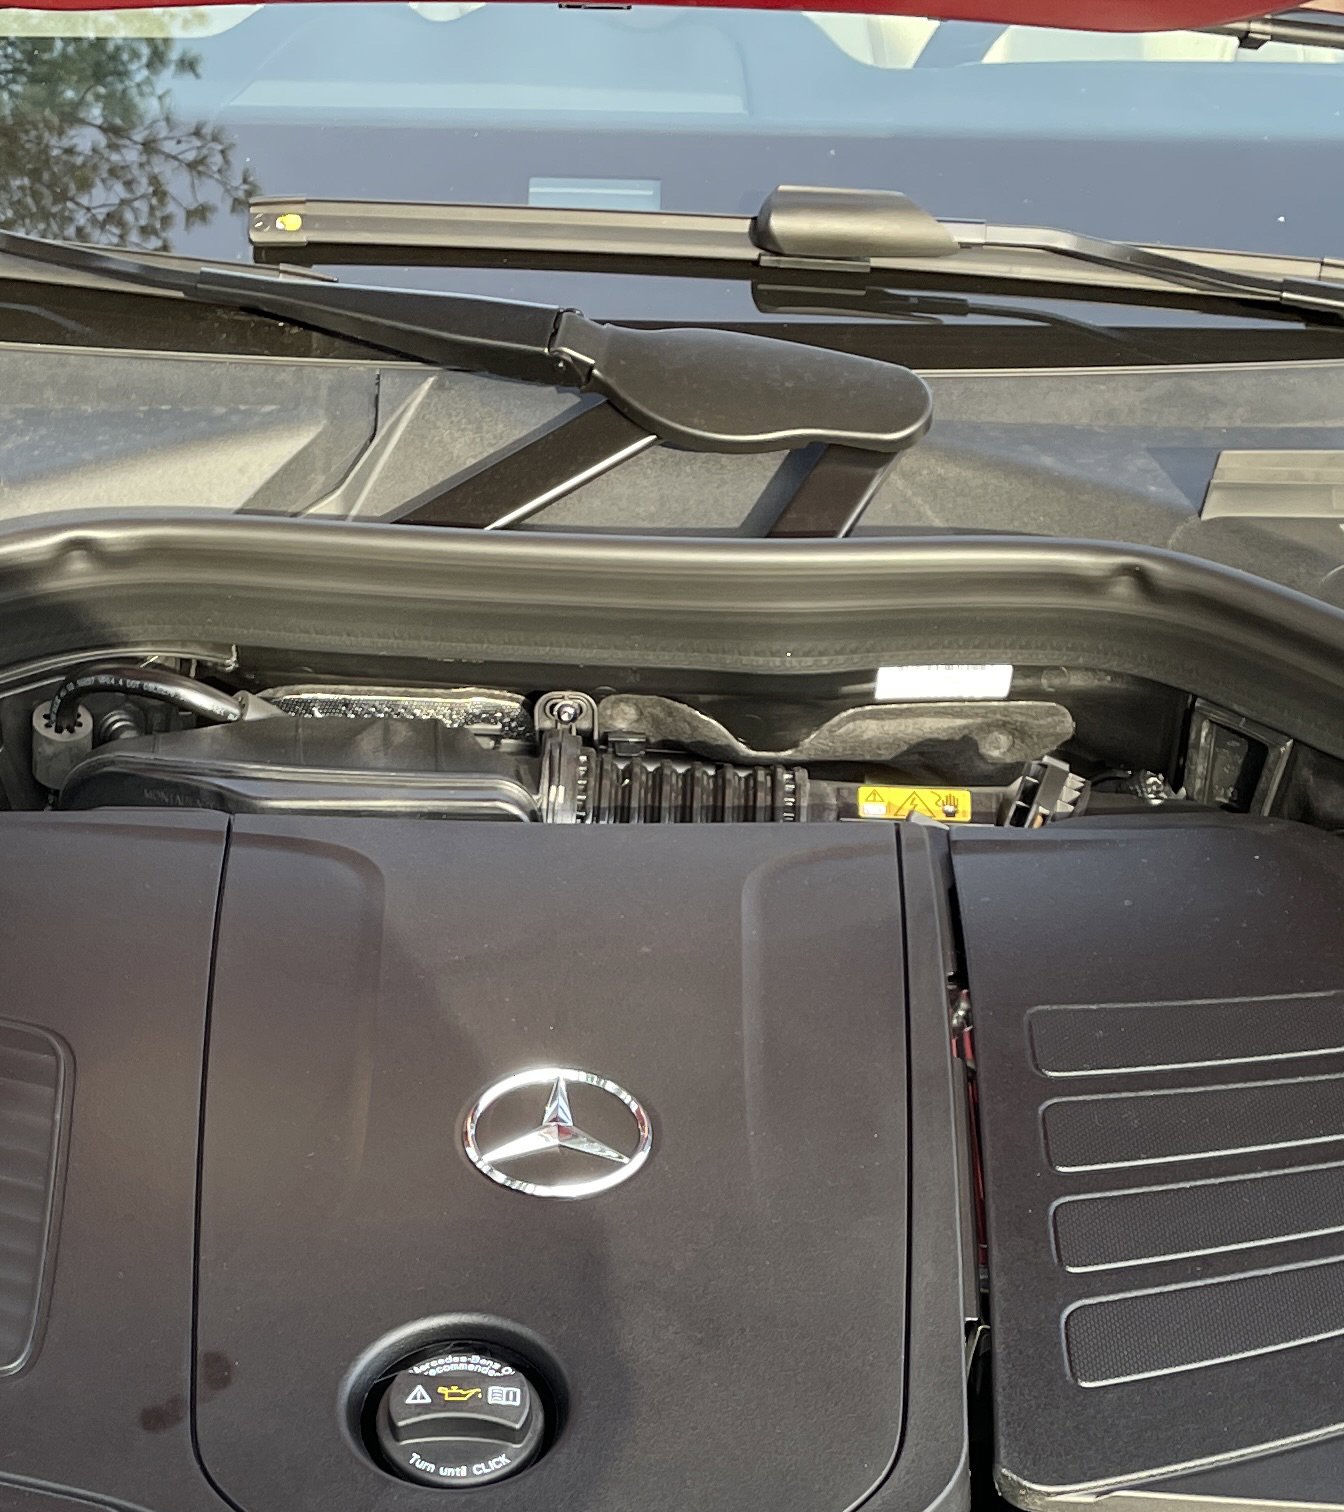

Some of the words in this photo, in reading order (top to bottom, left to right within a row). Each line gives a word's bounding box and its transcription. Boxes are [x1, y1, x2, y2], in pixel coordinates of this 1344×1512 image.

[409, 1452, 435, 1473] Turn
[439, 1465, 467, 1477] until
[472, 1453, 511, 1476] CLICK
